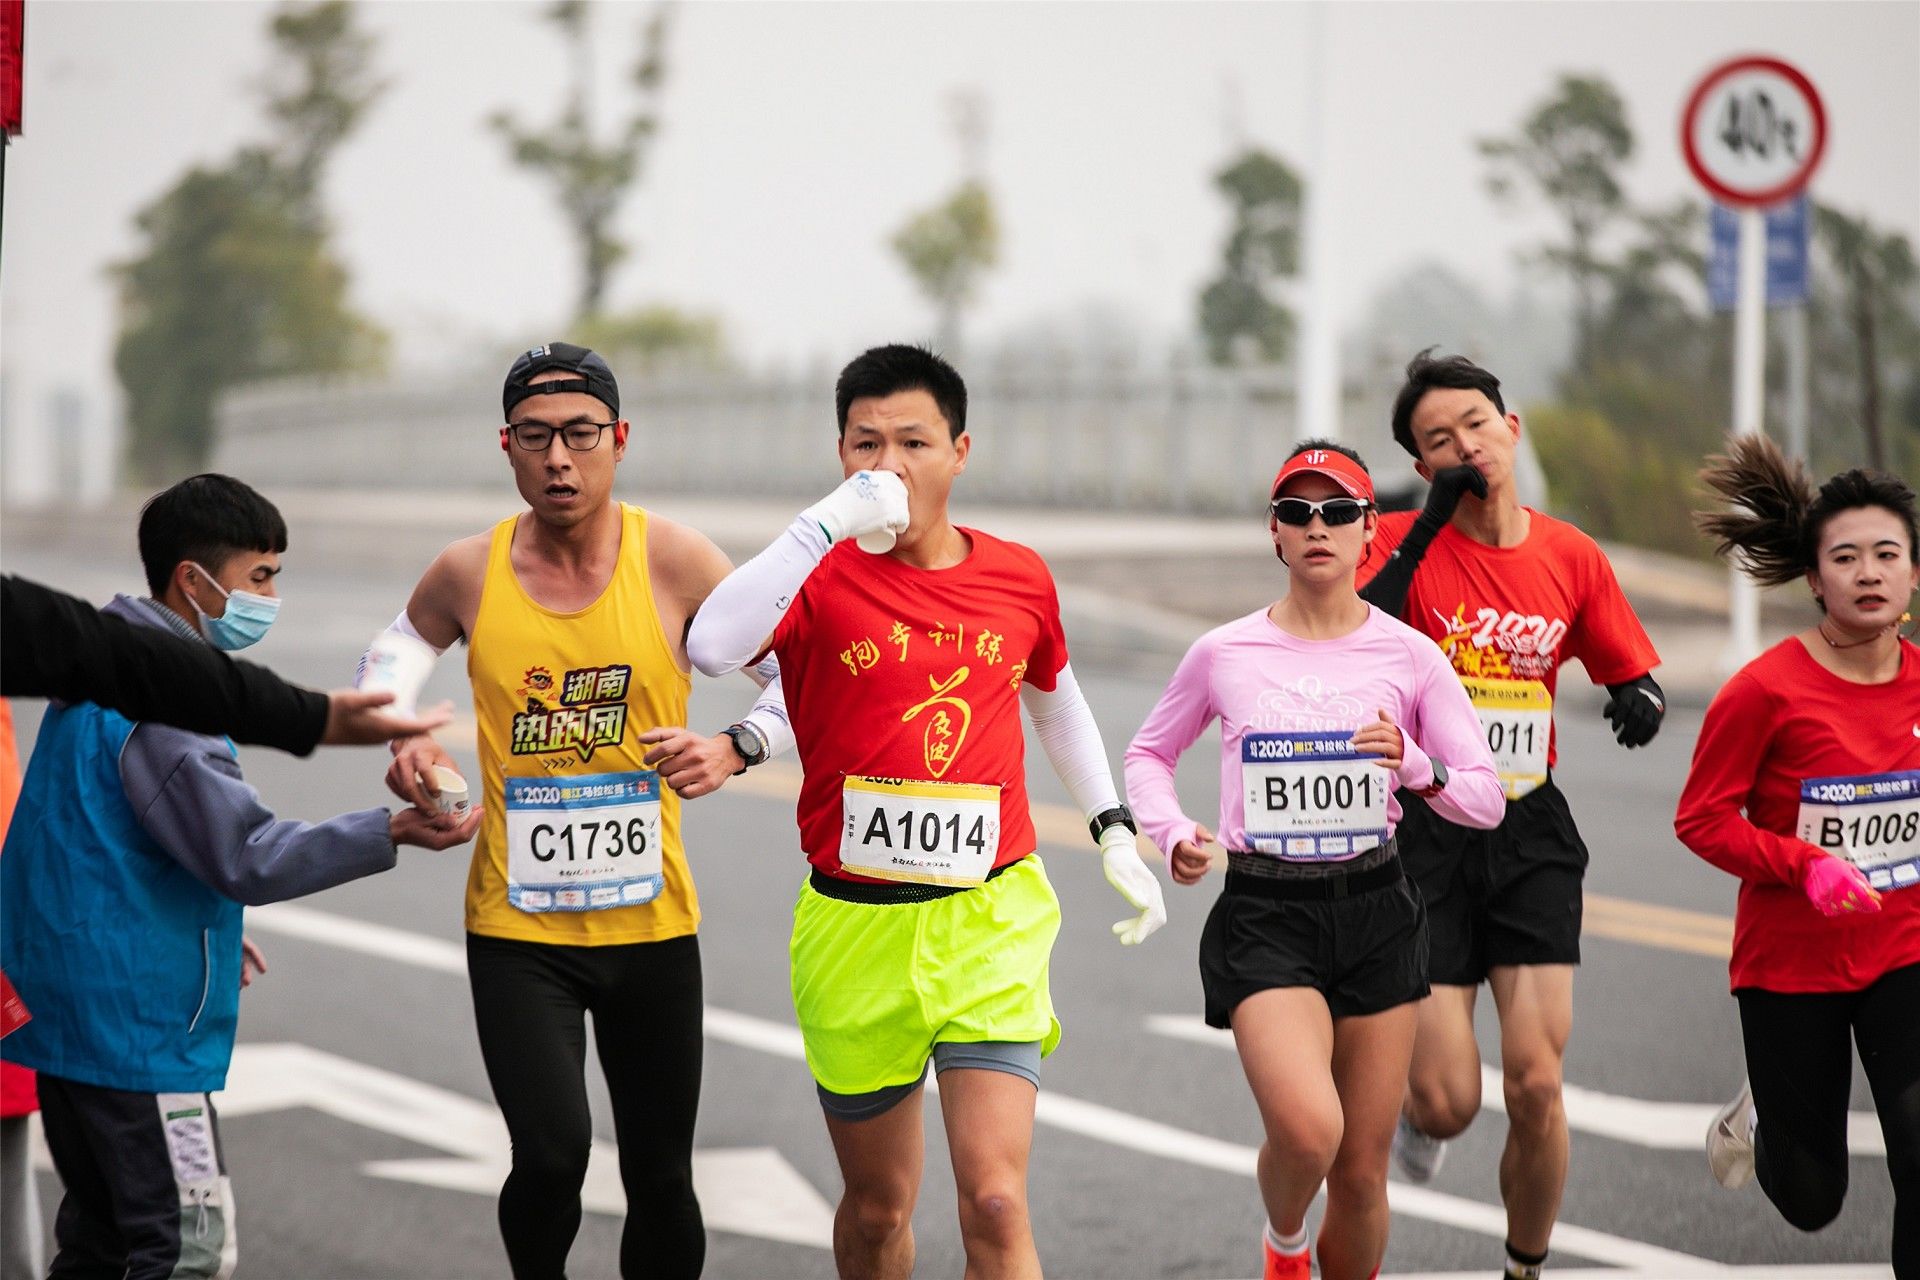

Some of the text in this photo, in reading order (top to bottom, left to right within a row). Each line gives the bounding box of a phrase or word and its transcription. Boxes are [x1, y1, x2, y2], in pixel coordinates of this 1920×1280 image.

[1472, 607, 1567, 656] 2020
[565, 669, 628, 702] 湖南
[513, 704, 626, 759] 热跑团
[1483, 722, 1534, 754] 011
[1265, 773, 1371, 811] B1001
[530, 818, 646, 862] C1736
[862, 807, 985, 855] A1014
[1820, 811, 1919, 848] B1008
